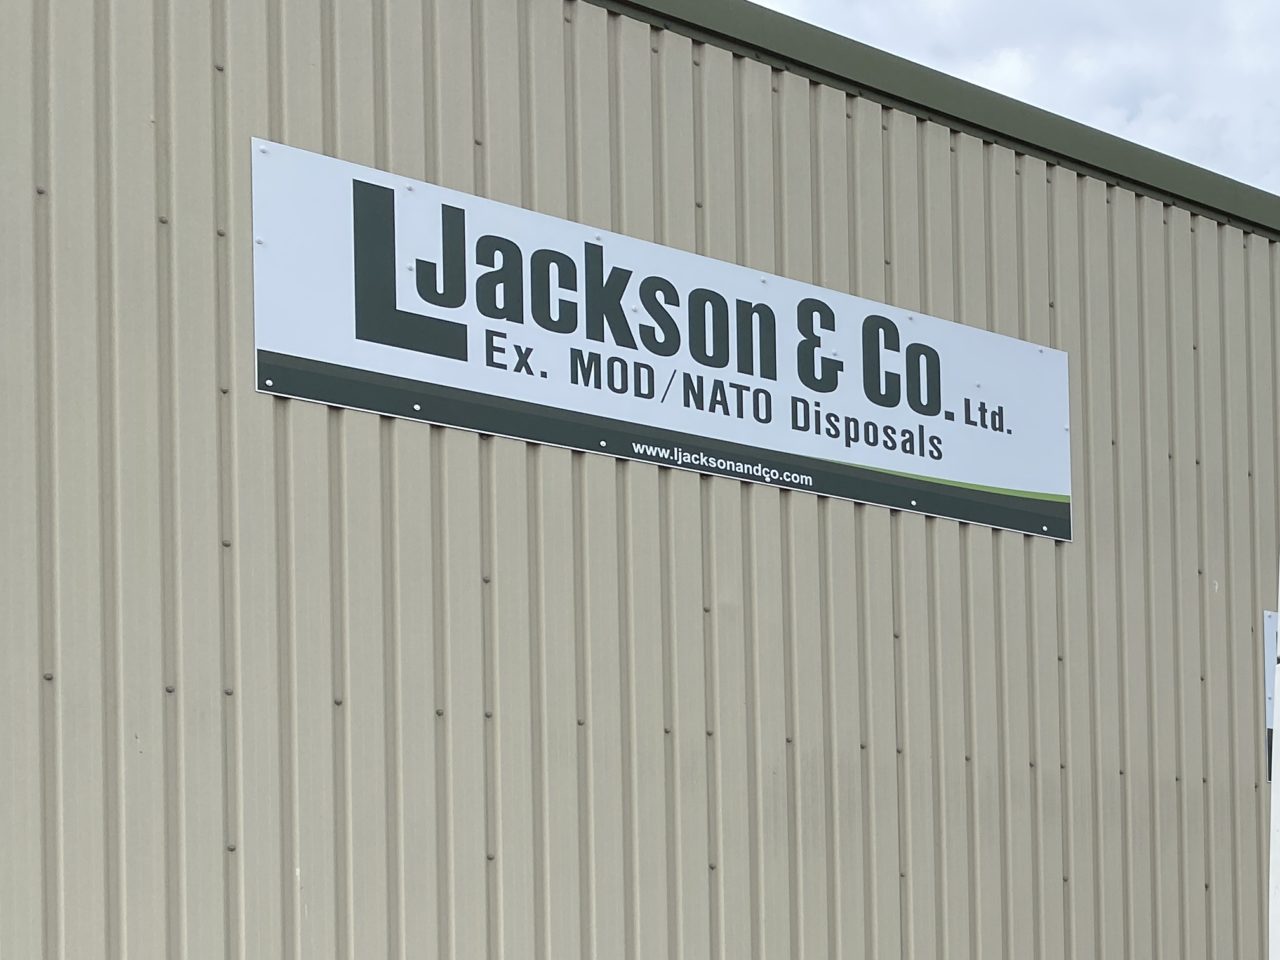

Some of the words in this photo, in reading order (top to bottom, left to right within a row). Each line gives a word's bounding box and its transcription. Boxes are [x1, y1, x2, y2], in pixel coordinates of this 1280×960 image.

[485, 330, 549, 379] Ex.
[570, 349, 774, 425] MOD/NATO
[791, 397, 943, 462] Disposals
[796, 298, 844, 394] &
[861, 314, 954, 423] Co.
[964, 397, 1013, 436] Ltd.
[632, 442, 813, 486] www.ljacksonandco.com
